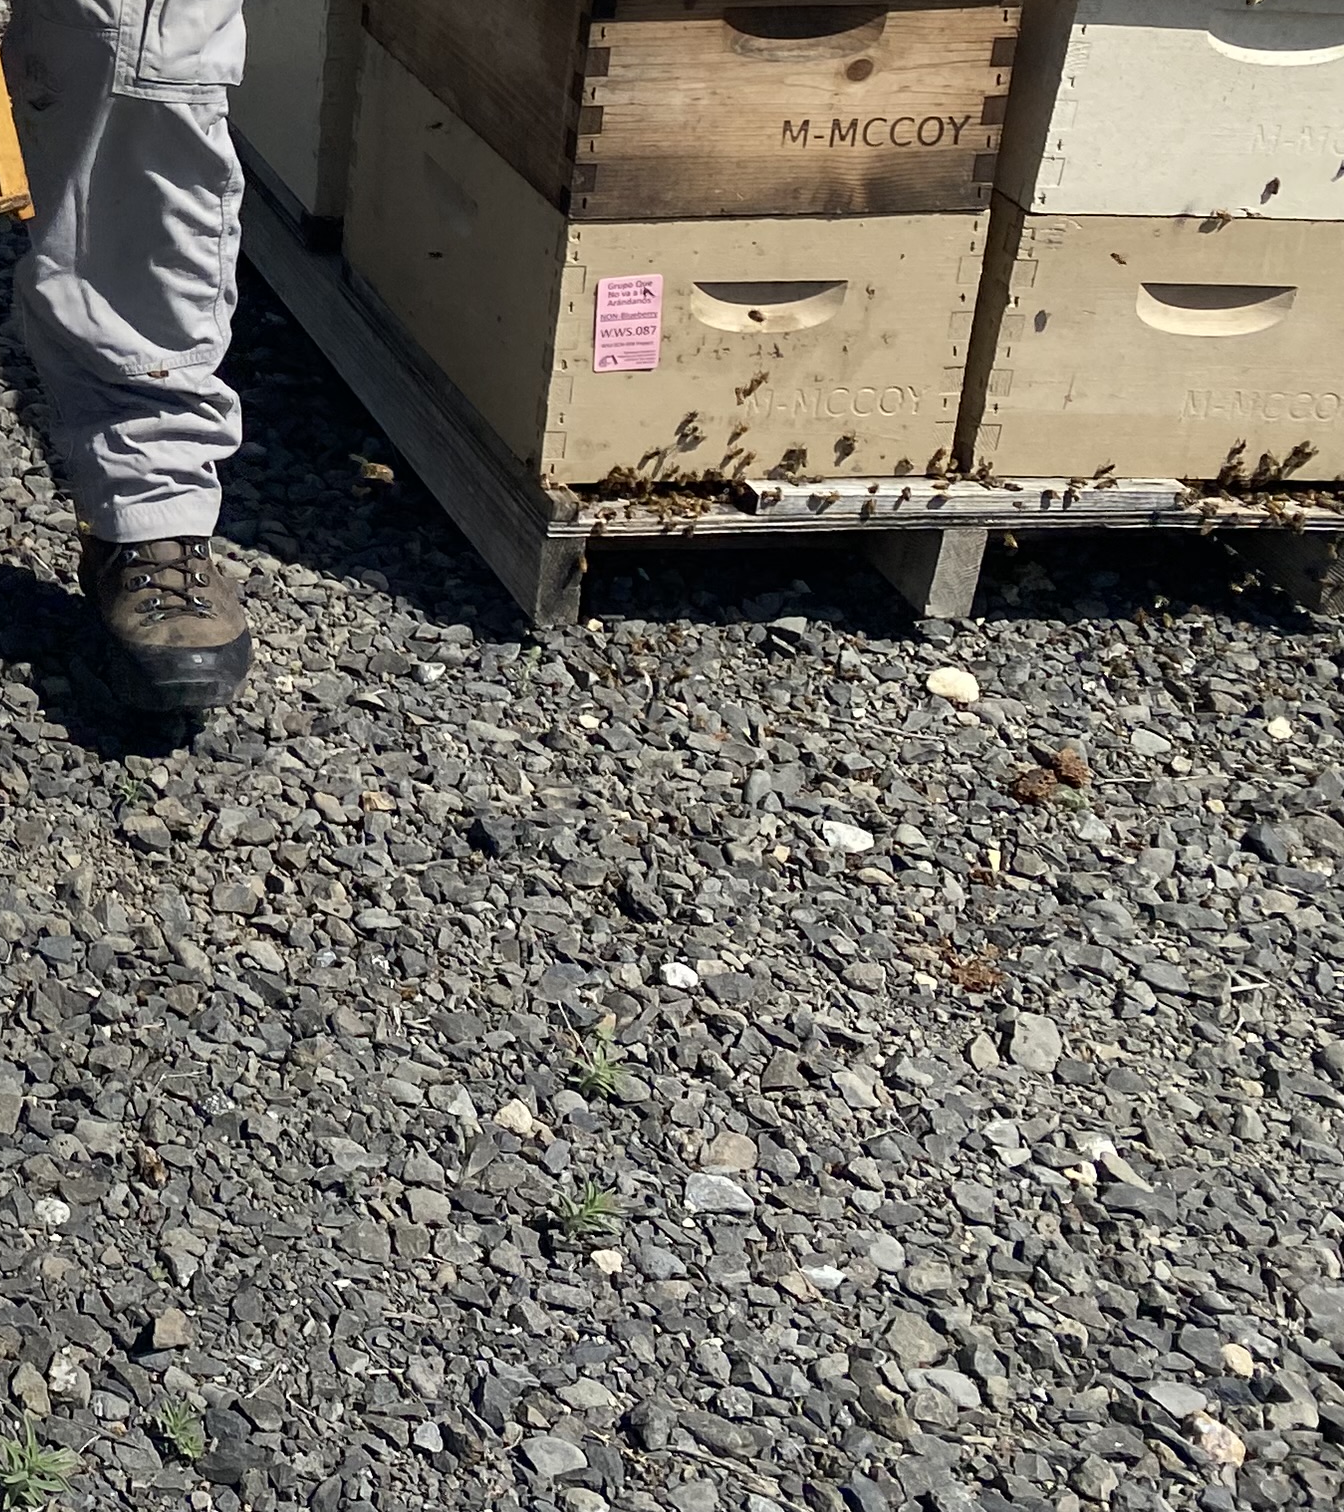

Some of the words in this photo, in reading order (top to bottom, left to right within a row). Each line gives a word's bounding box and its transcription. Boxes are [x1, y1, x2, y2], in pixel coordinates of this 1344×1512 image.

[781, 114, 972, 149] M-MCCOY
[635, 279, 653, 288] Que
[743, 384, 926, 418] M-MCCOY
[1182, 389, 1344, 422] M-MCCO
